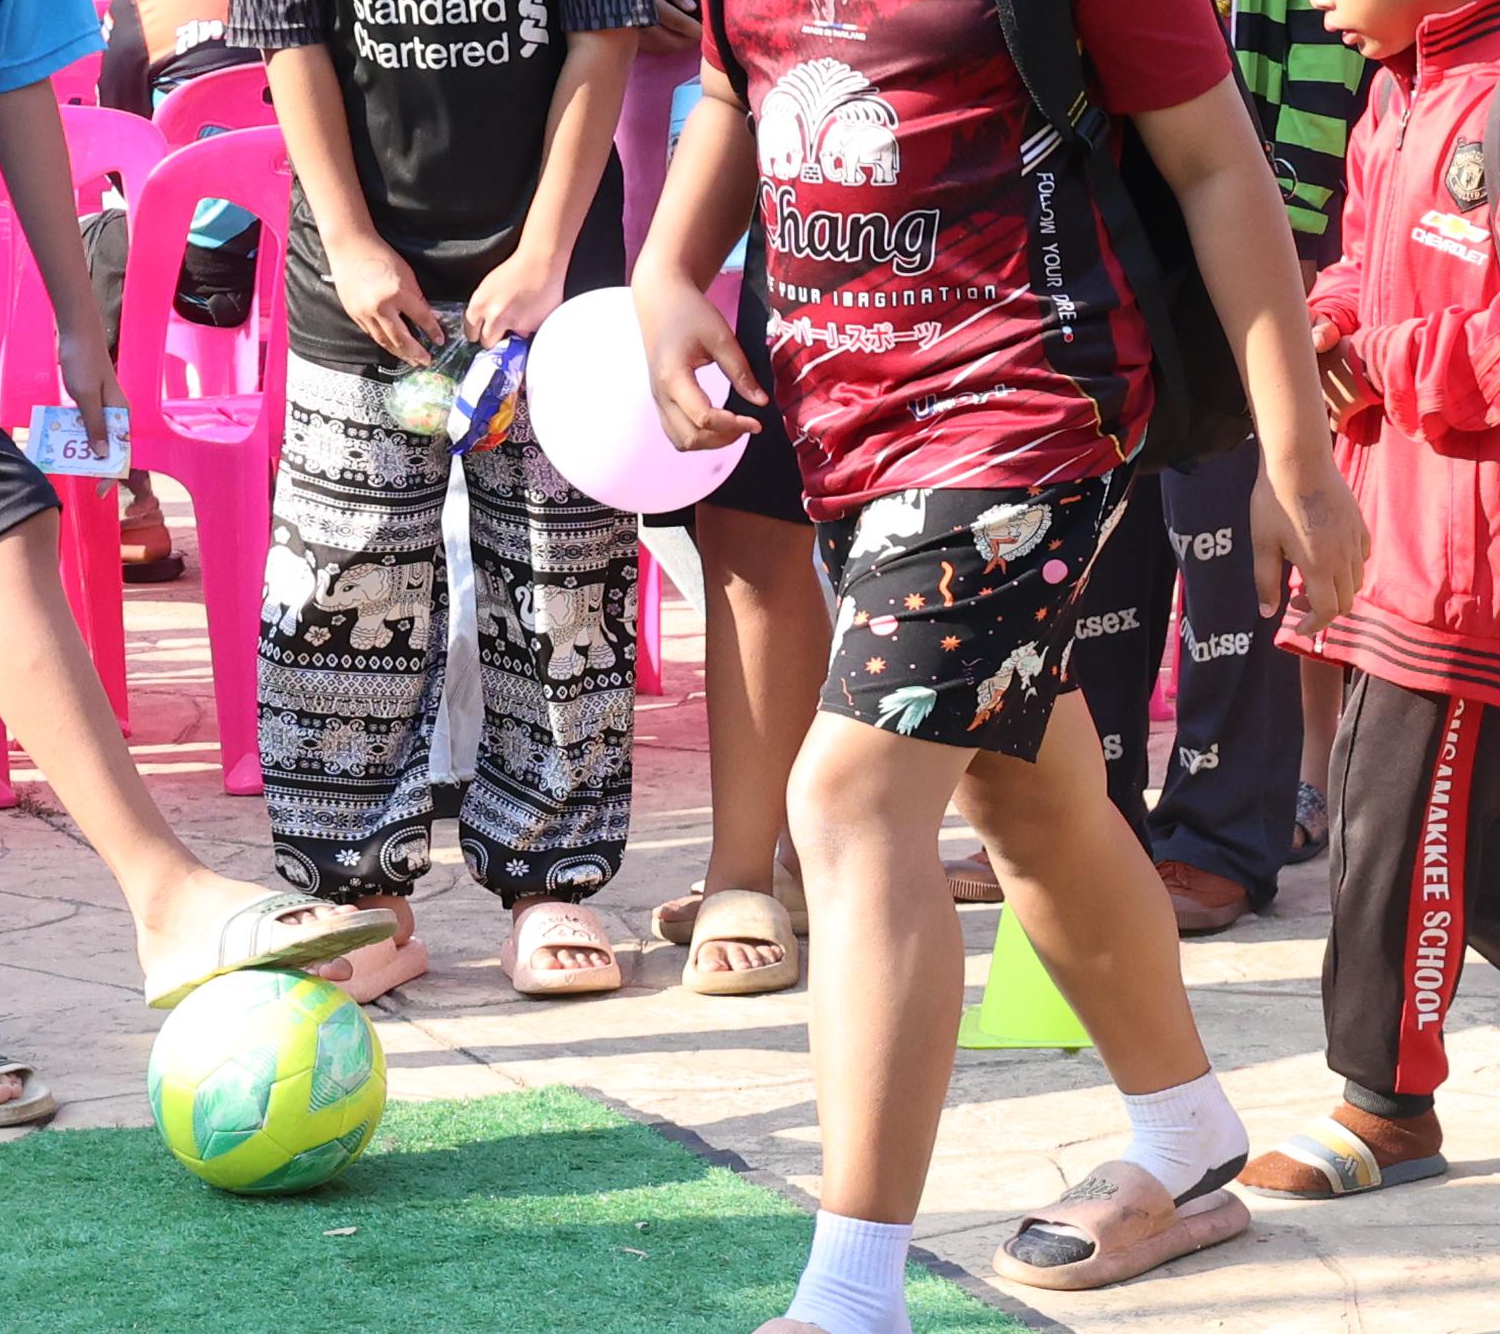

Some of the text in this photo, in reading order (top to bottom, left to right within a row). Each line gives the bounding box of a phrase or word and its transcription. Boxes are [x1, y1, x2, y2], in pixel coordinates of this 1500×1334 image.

[354, 21, 510, 70] Chartered
[760, 177, 940, 277] Chang
[1042, 243, 1063, 287] YOUR
[779, 281, 820, 305] YOUR
[833, 285, 996, 308] IMAGINATION
[1414, 910, 1451, 1031] SCHOOL
